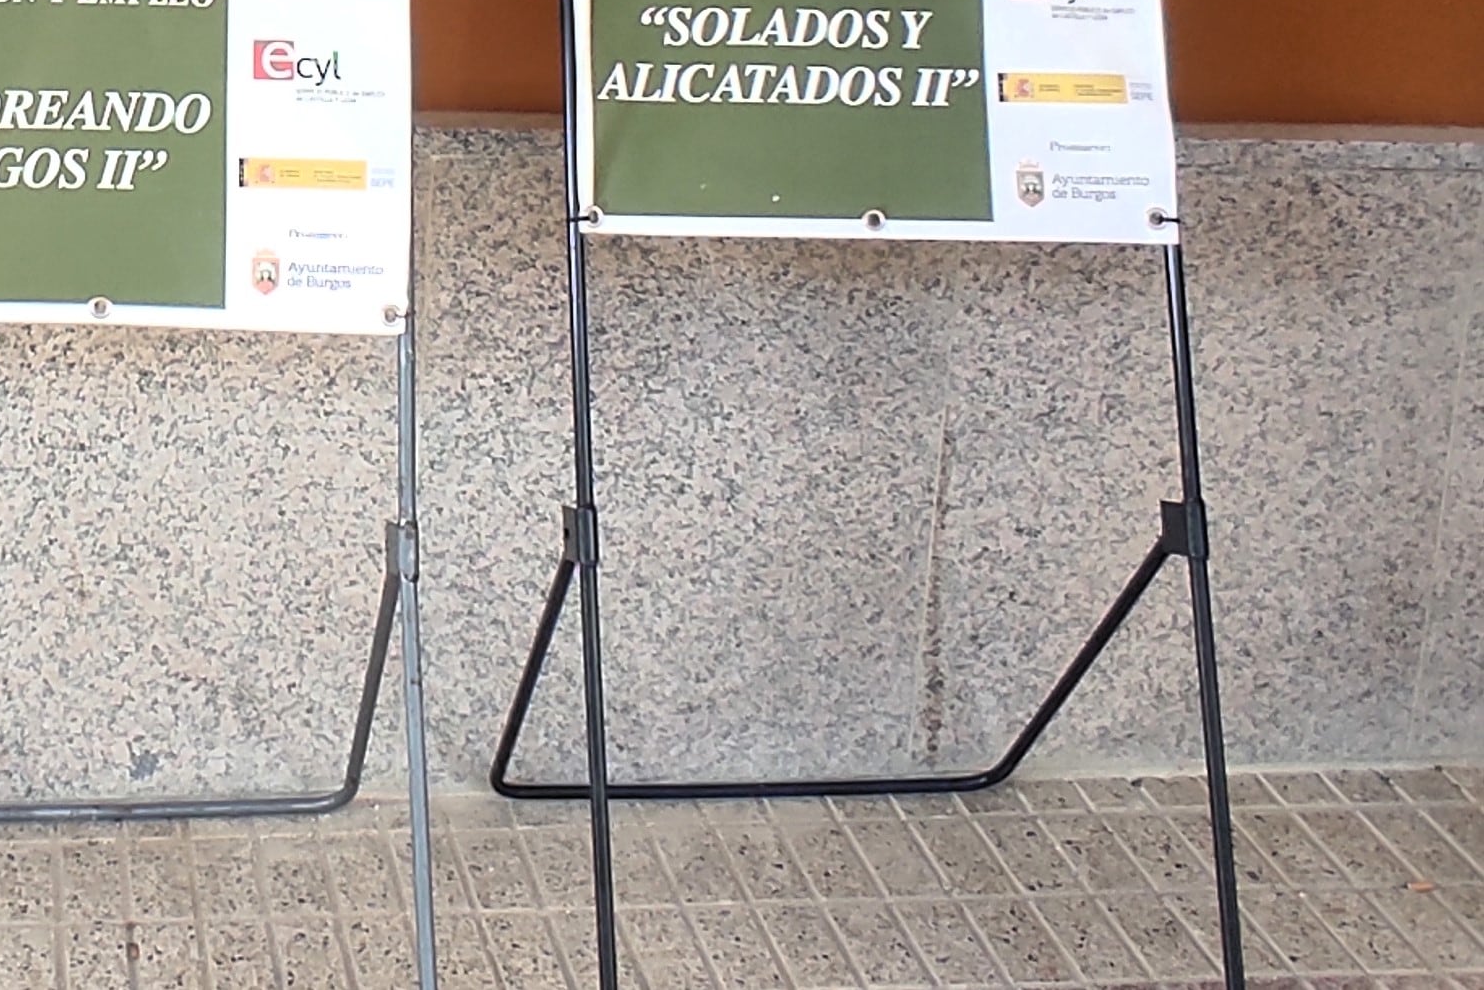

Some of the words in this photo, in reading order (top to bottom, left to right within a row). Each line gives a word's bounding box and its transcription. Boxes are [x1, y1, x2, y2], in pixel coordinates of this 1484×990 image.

[640, 6, 891, 49] “SOLADOS
[900, 10, 933, 49] Y
[596, 62, 903, 107] ALICATADOS
[911, 68, 980, 107] II”
[96, 150, 168, 190] II”
[1051, 173, 1150, 187] Ayuntamiento
[1051, 188, 1068, 199] de
[1071, 187, 1117, 202] Burgos
[287, 261, 385, 276] Ayuntamiento
[287, 277, 303, 288] de
[306, 276, 352, 290] Burgos
